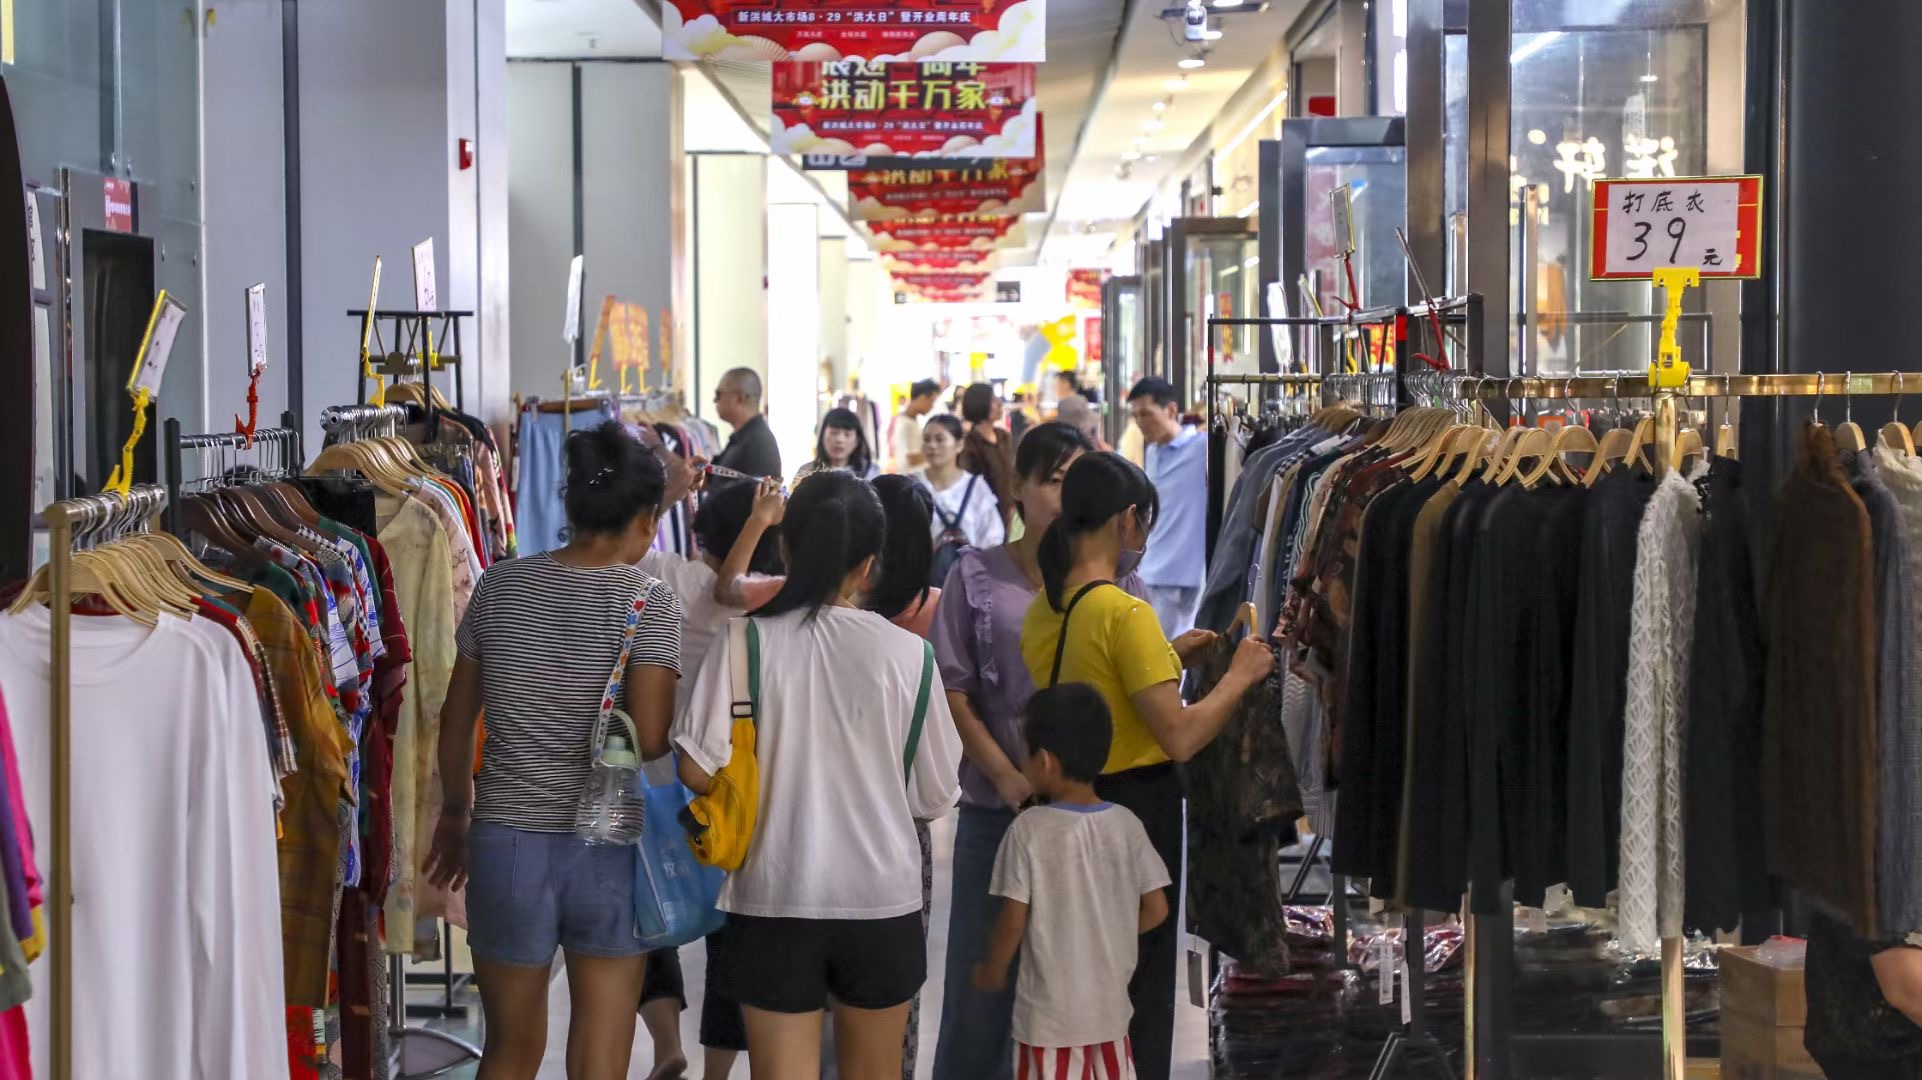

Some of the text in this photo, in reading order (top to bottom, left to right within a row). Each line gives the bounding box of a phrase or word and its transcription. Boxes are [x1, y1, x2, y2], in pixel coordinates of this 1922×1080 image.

[820, 79, 987, 110] 洪动千万家
[1621, 190, 1705, 214] 打底衣
[1626, 216, 1724, 266] 39 元
